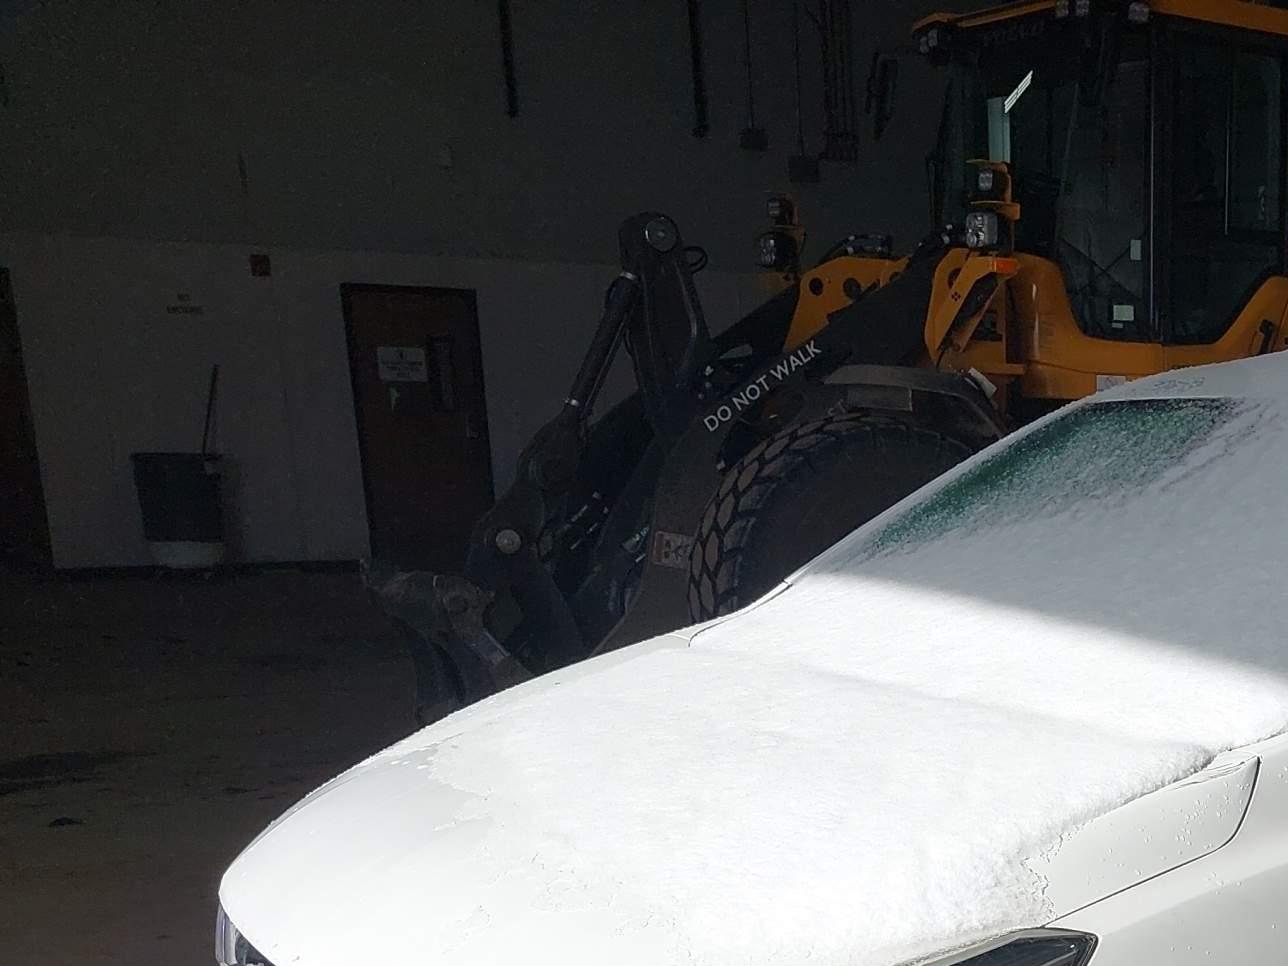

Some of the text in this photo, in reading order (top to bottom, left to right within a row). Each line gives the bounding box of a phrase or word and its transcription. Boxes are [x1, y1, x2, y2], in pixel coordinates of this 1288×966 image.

[704, 340, 822, 432] DO NOT WALK
